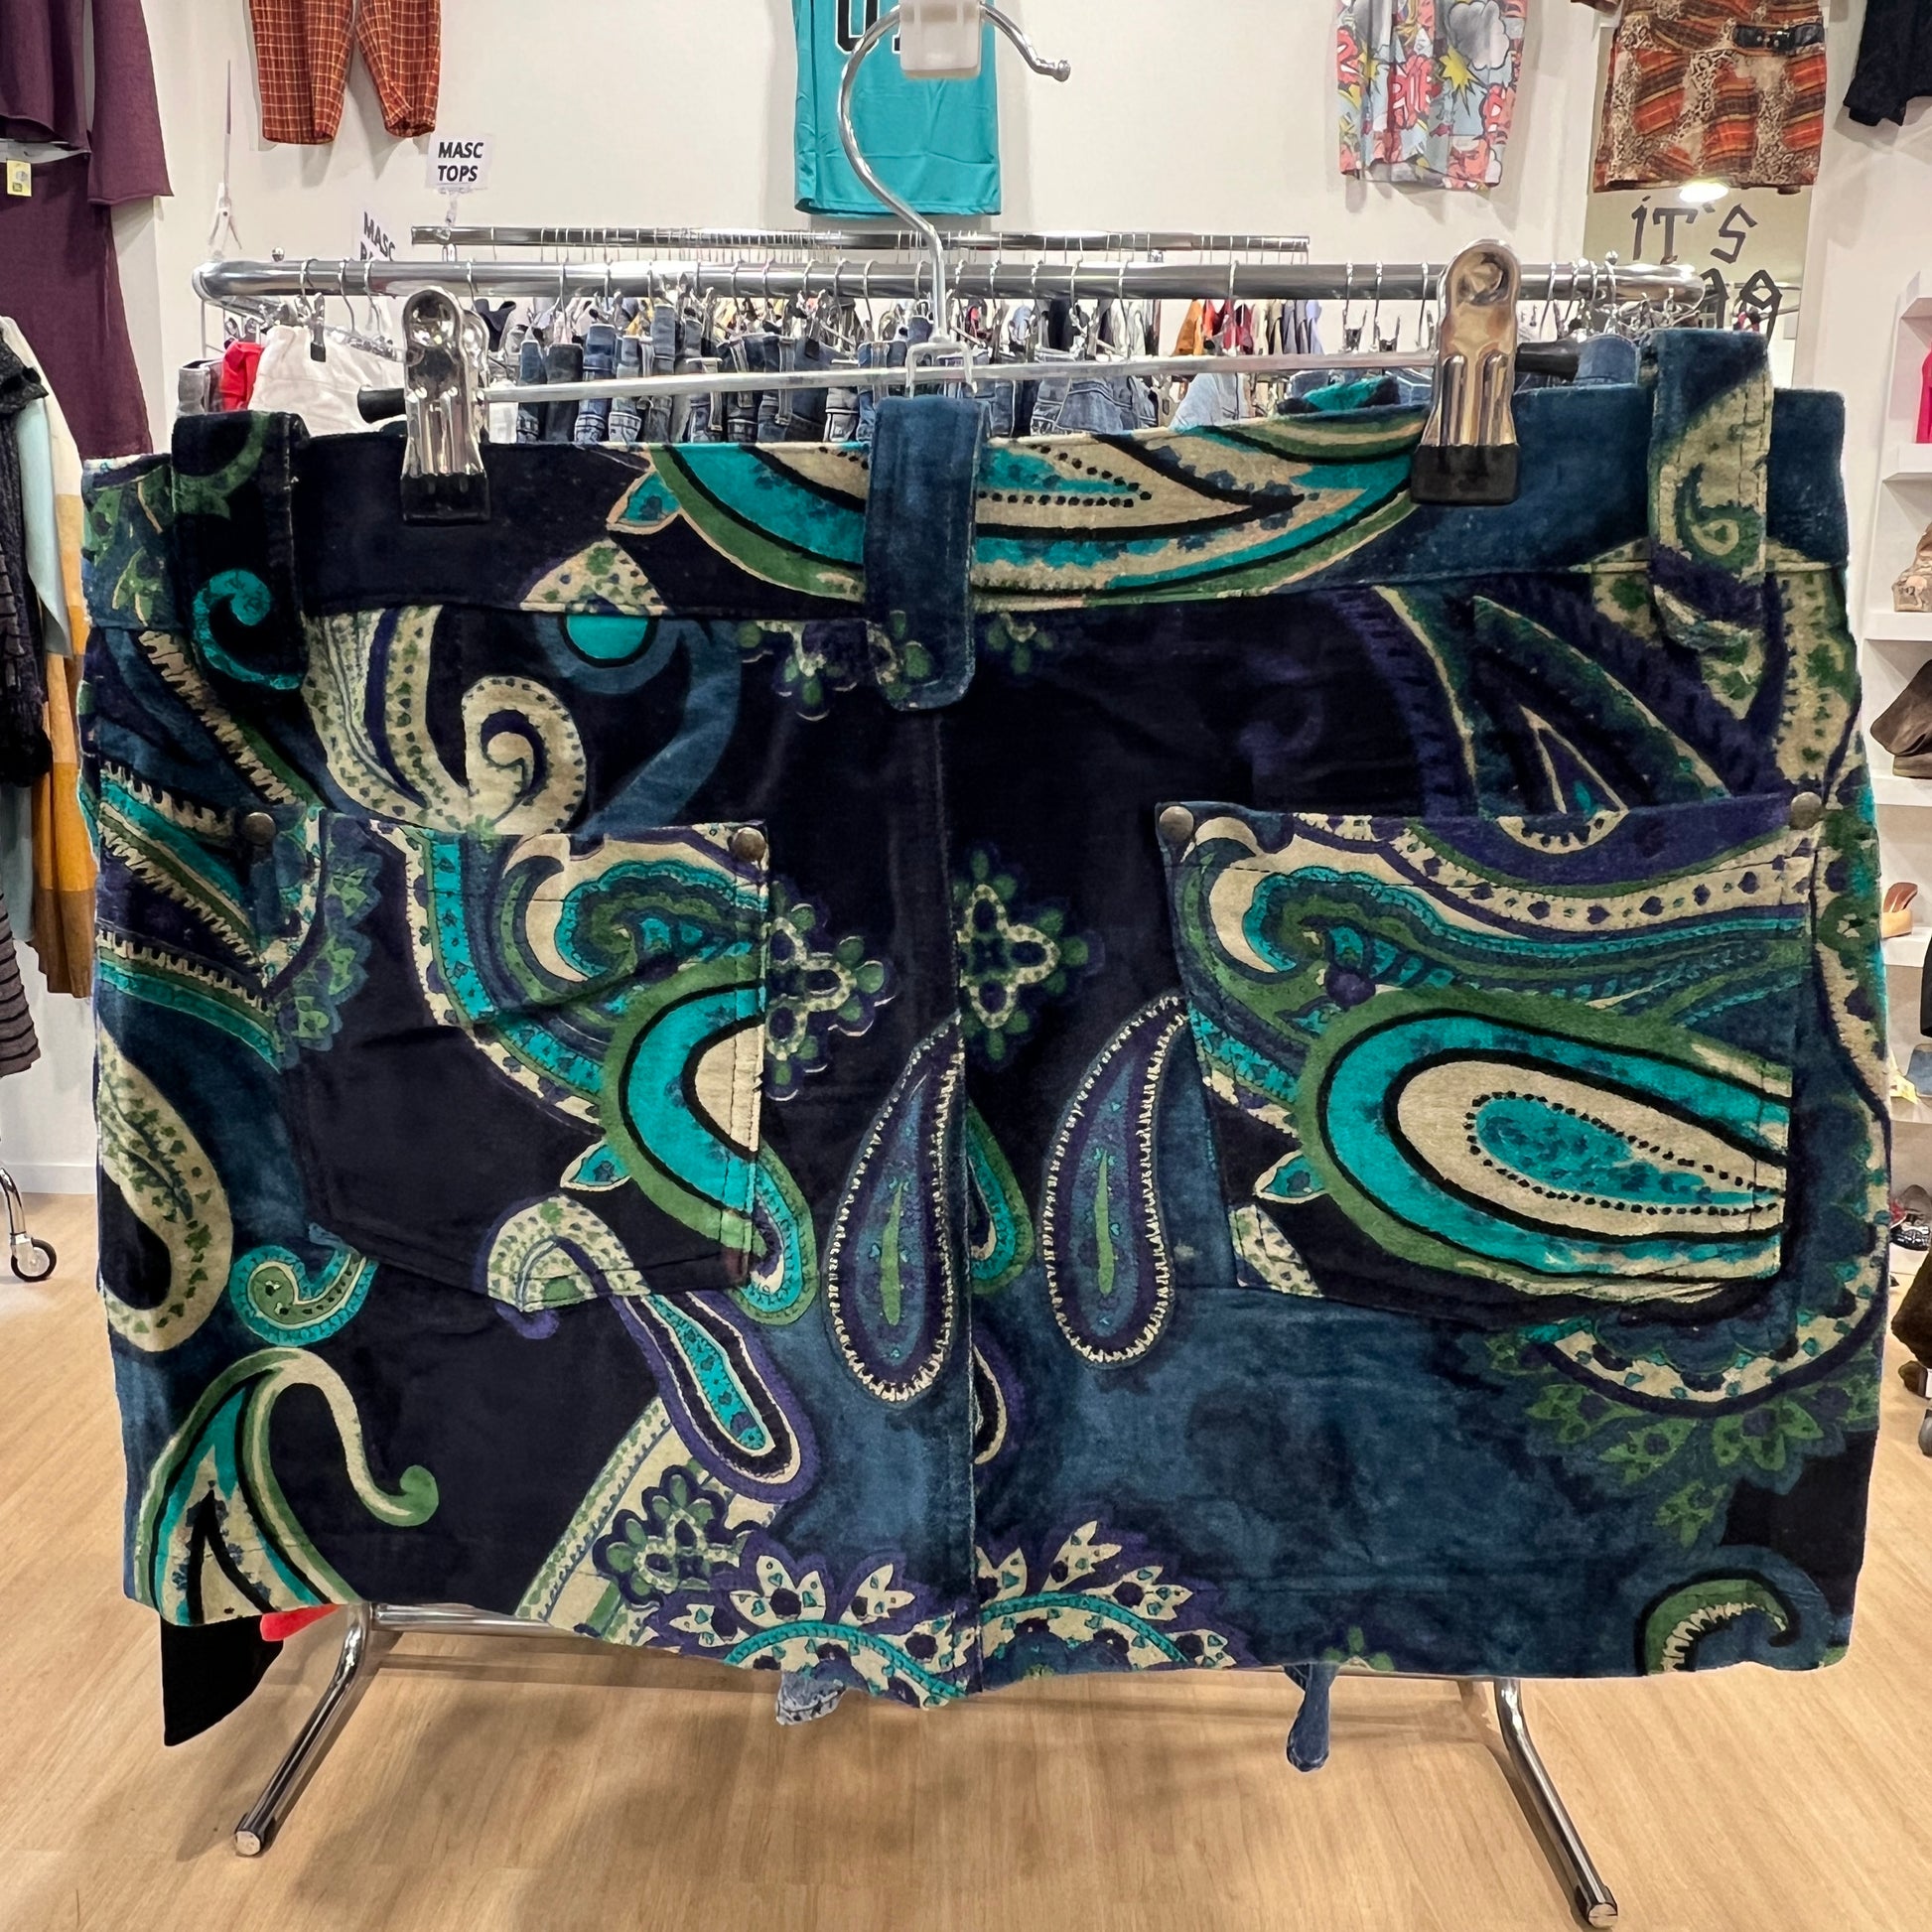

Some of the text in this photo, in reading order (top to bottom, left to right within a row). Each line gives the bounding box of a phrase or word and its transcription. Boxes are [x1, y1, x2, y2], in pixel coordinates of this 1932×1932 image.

[438, 142, 483, 159] MASC
[438, 165, 479, 182] TOPS
[363, 210, 396, 262] MASC
